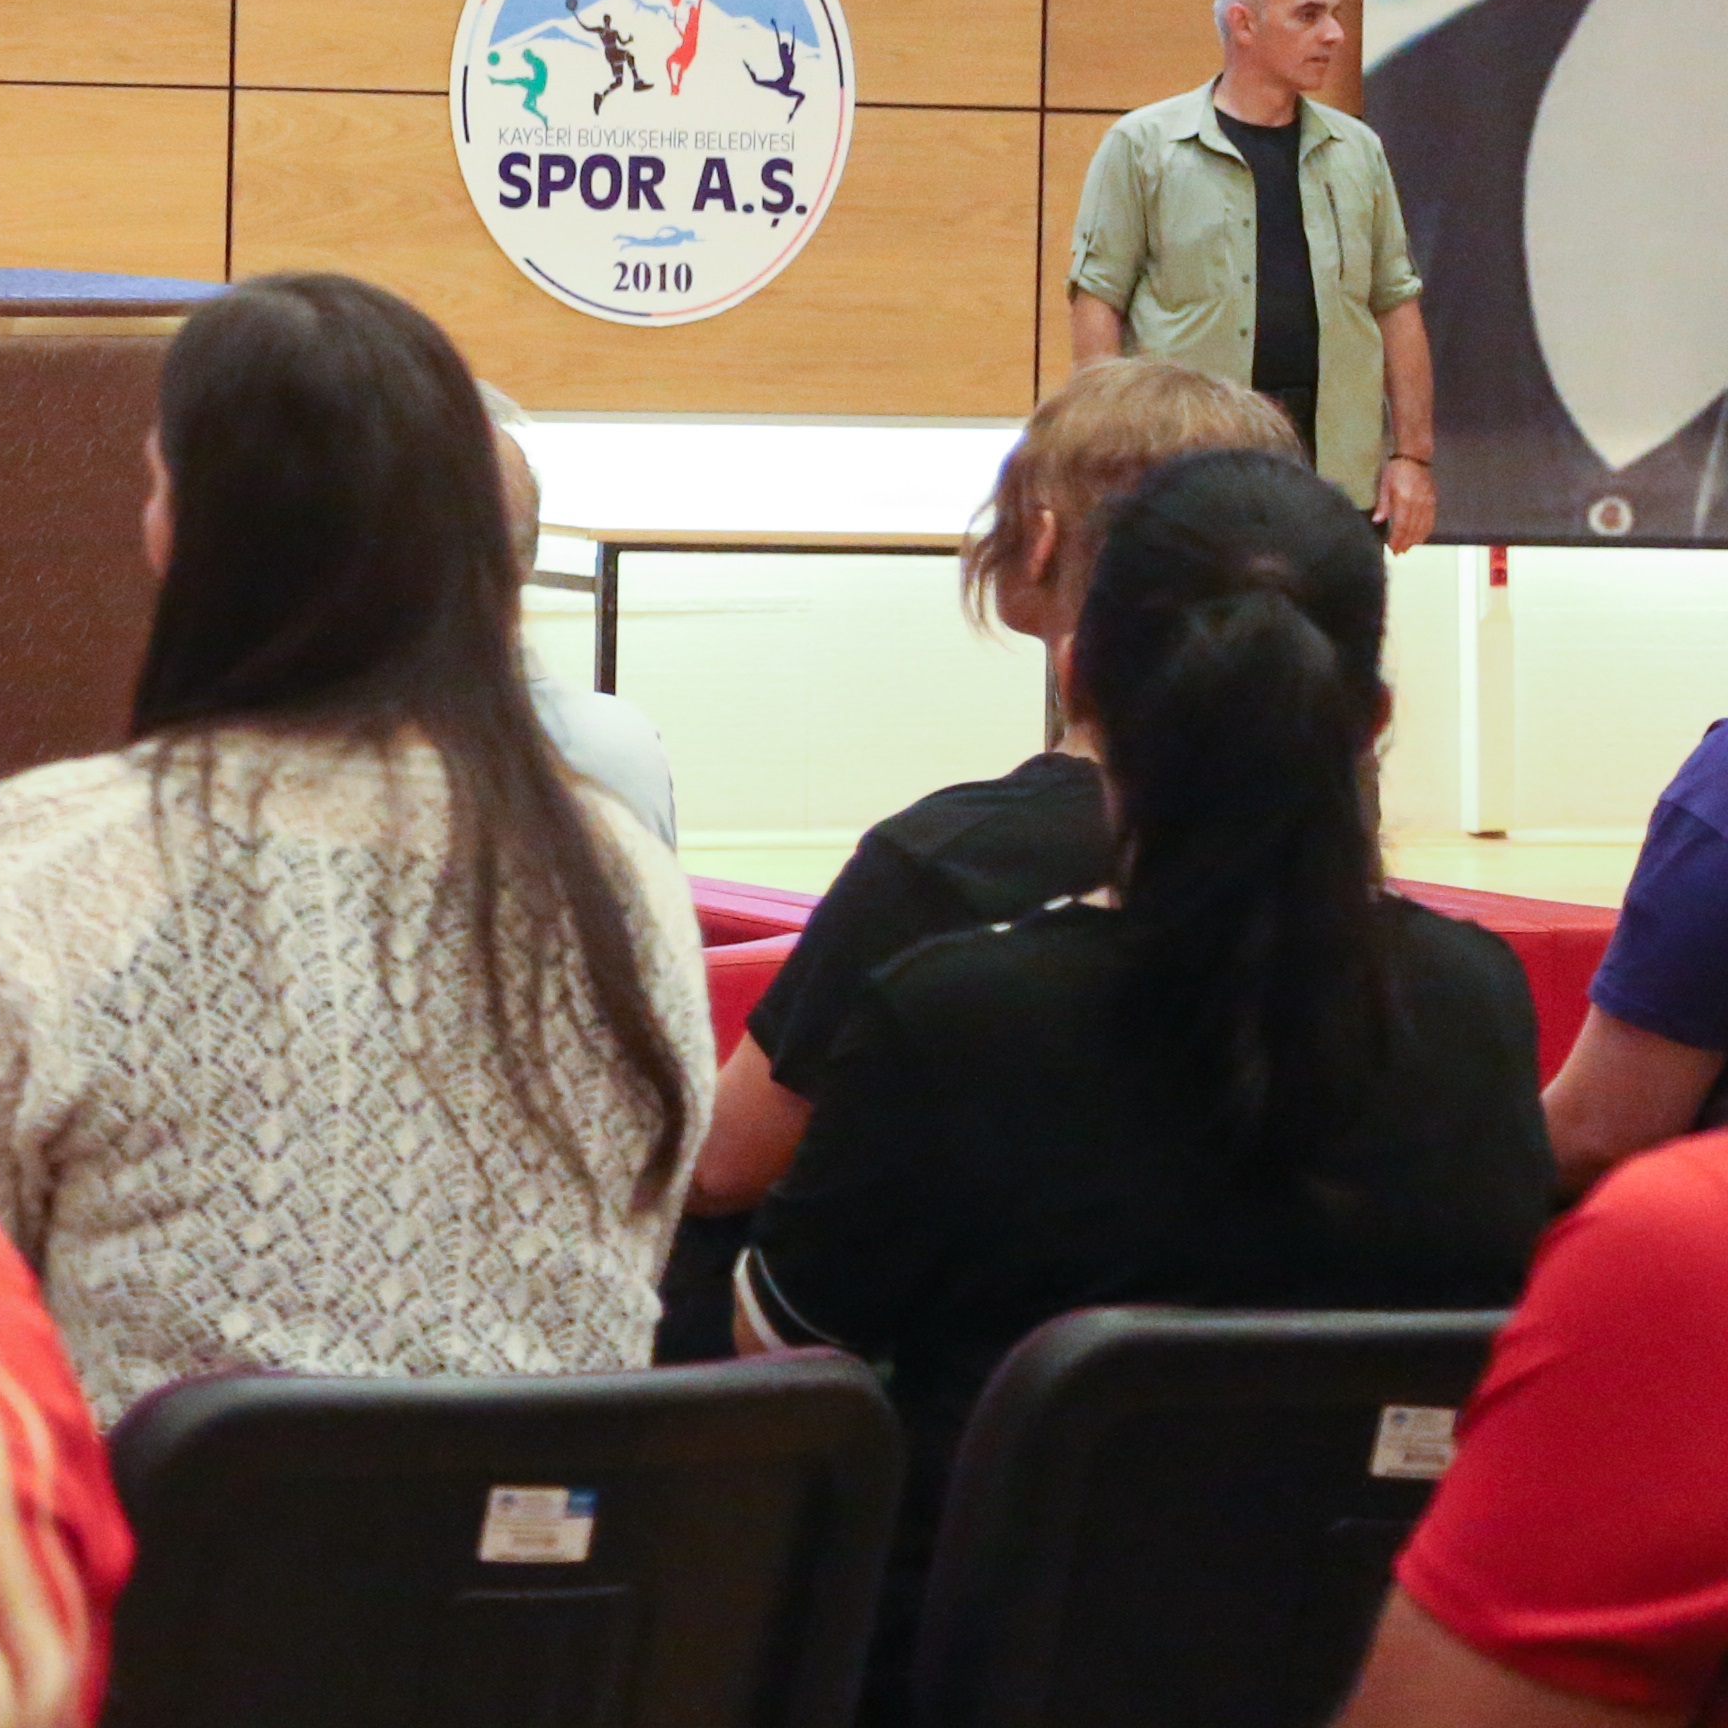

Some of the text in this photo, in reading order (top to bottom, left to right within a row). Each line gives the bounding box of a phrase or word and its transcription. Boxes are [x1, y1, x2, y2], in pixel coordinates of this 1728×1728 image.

[498, 125, 795, 152] KAYSERİ BÜYÜKŞEHİR BELEDİYESİ
[498, 151, 808, 228] SPOR A.Ş.
[613, 262, 693, 292] 2010
